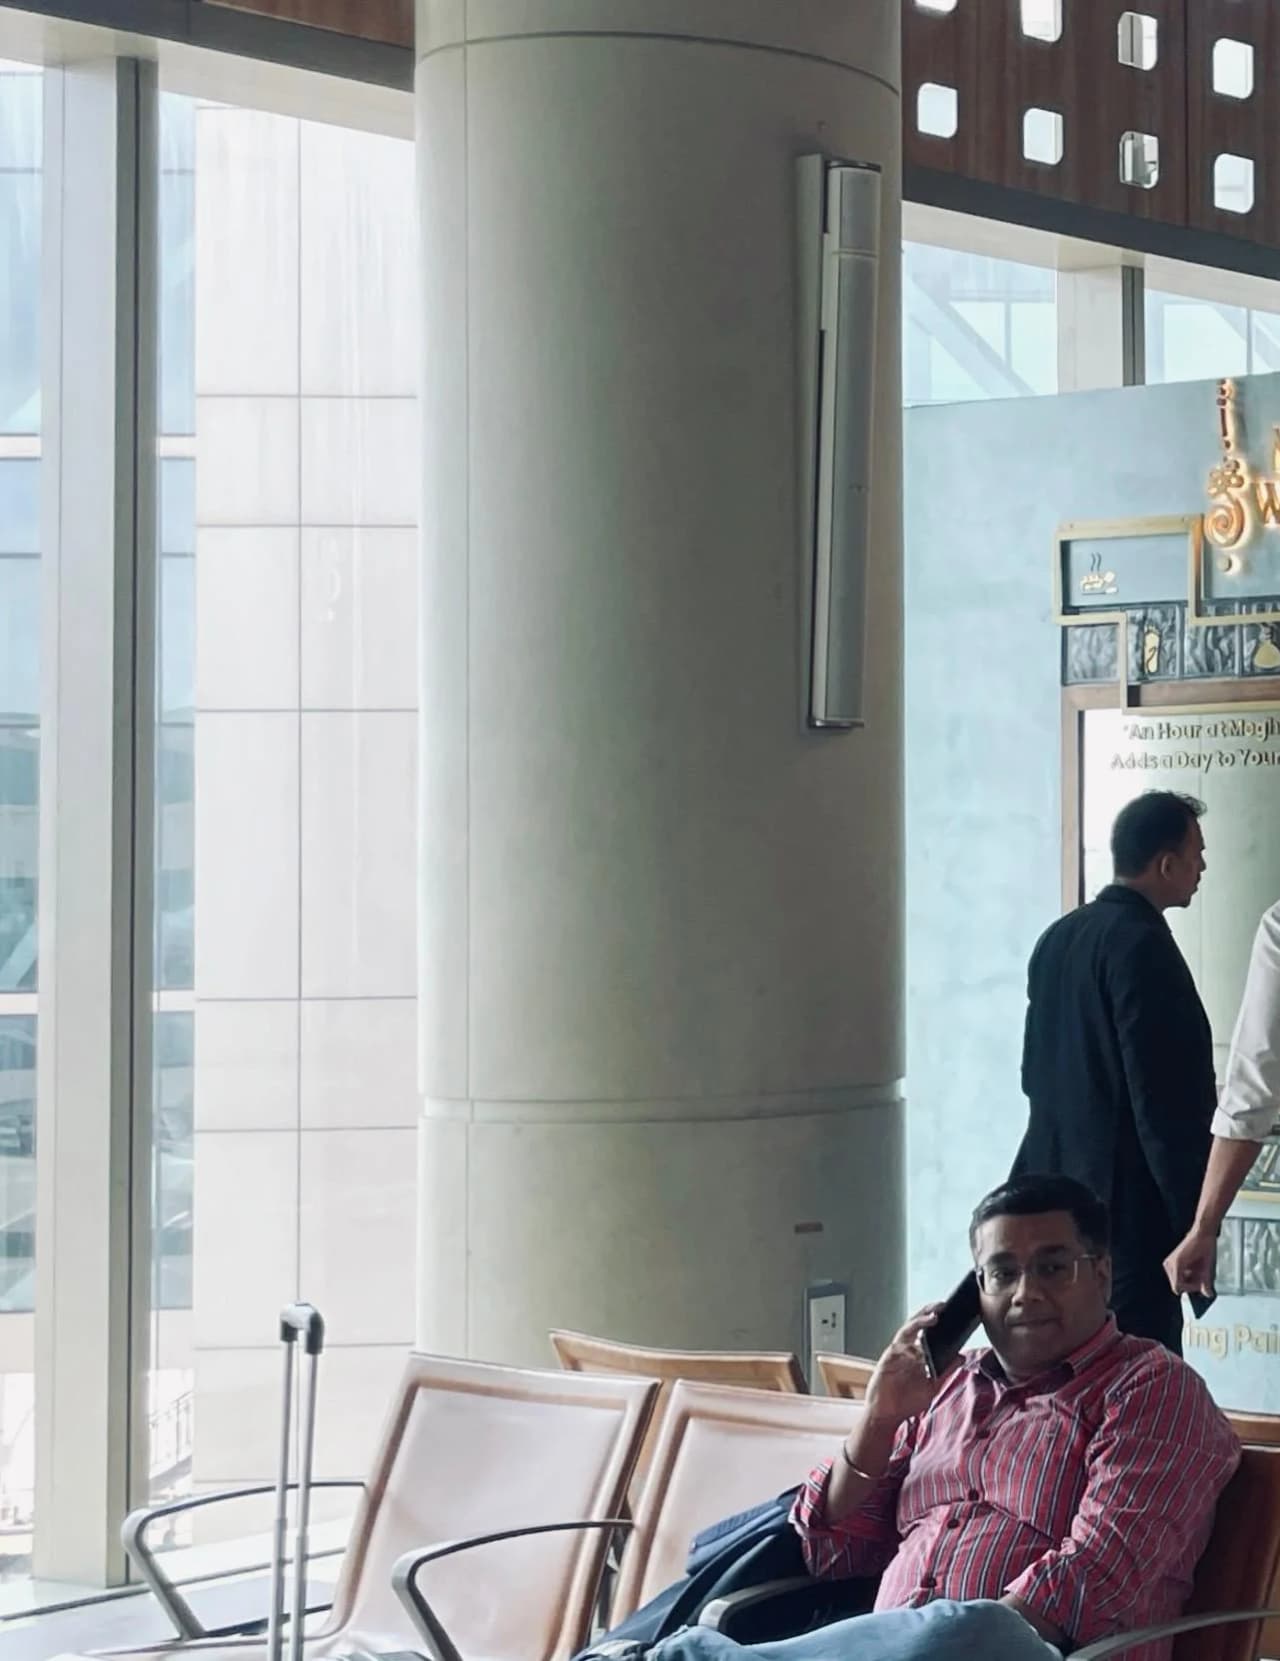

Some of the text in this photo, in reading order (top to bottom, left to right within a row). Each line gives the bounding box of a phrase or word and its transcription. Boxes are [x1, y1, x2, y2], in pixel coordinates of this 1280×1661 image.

[1158, 720, 1201, 740] Hour
[1206, 721, 1227, 738] at
[1111, 751, 1159, 771] Adds
[1162, 753, 1174, 769] a
[1177, 750, 1214, 774] Day
[1217, 750, 1236, 768] to
